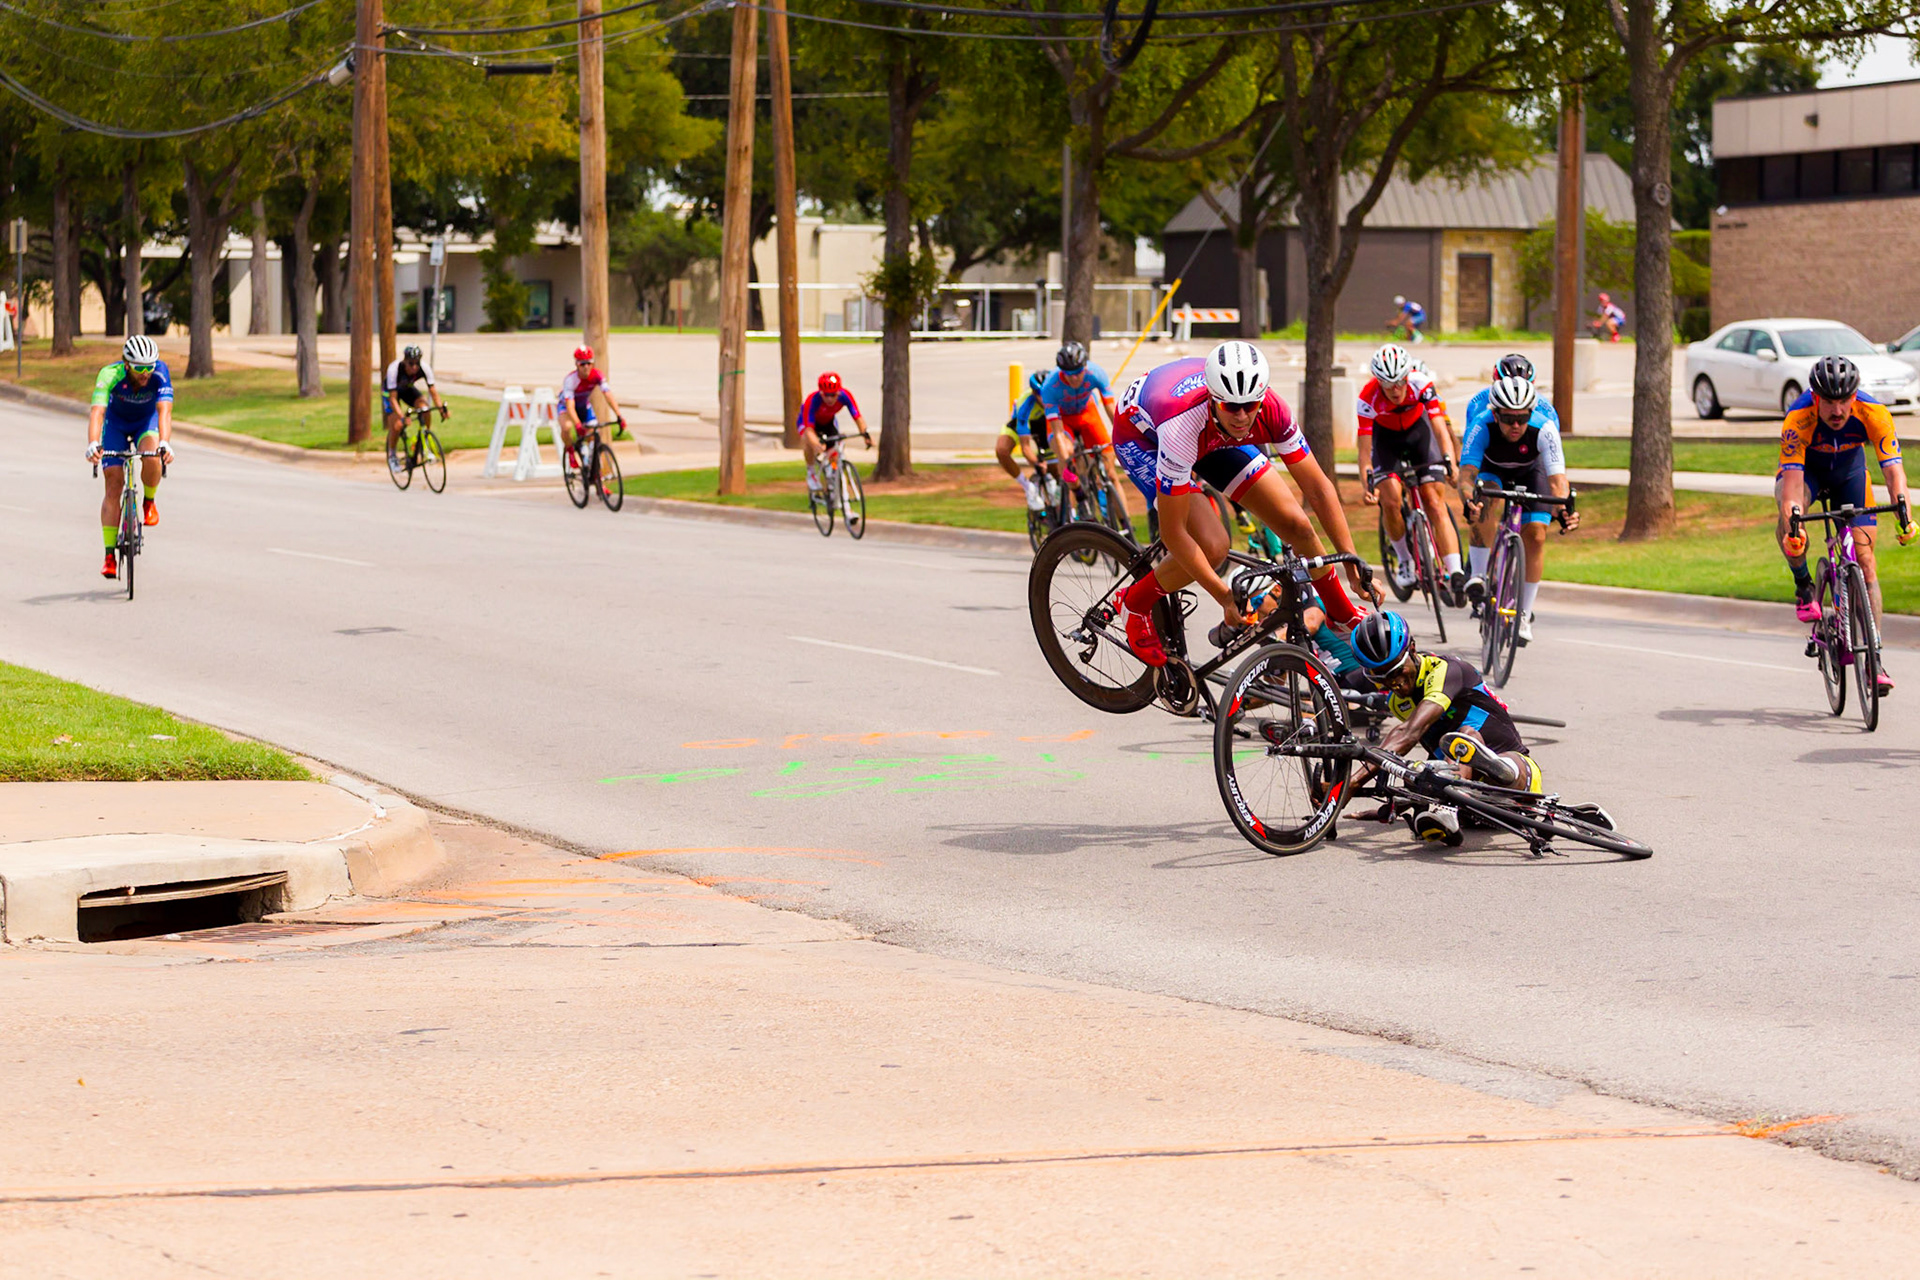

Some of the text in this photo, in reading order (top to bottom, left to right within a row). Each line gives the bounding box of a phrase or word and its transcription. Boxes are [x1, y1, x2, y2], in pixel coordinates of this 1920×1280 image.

[1217, 621, 1264, 662] TREK
[1235, 658, 1270, 702] MERCURY
[1314, 673, 1345, 726] MERCURY
[1226, 773, 1257, 828] MERCURY
[1303, 796, 1338, 841] MERCURY
